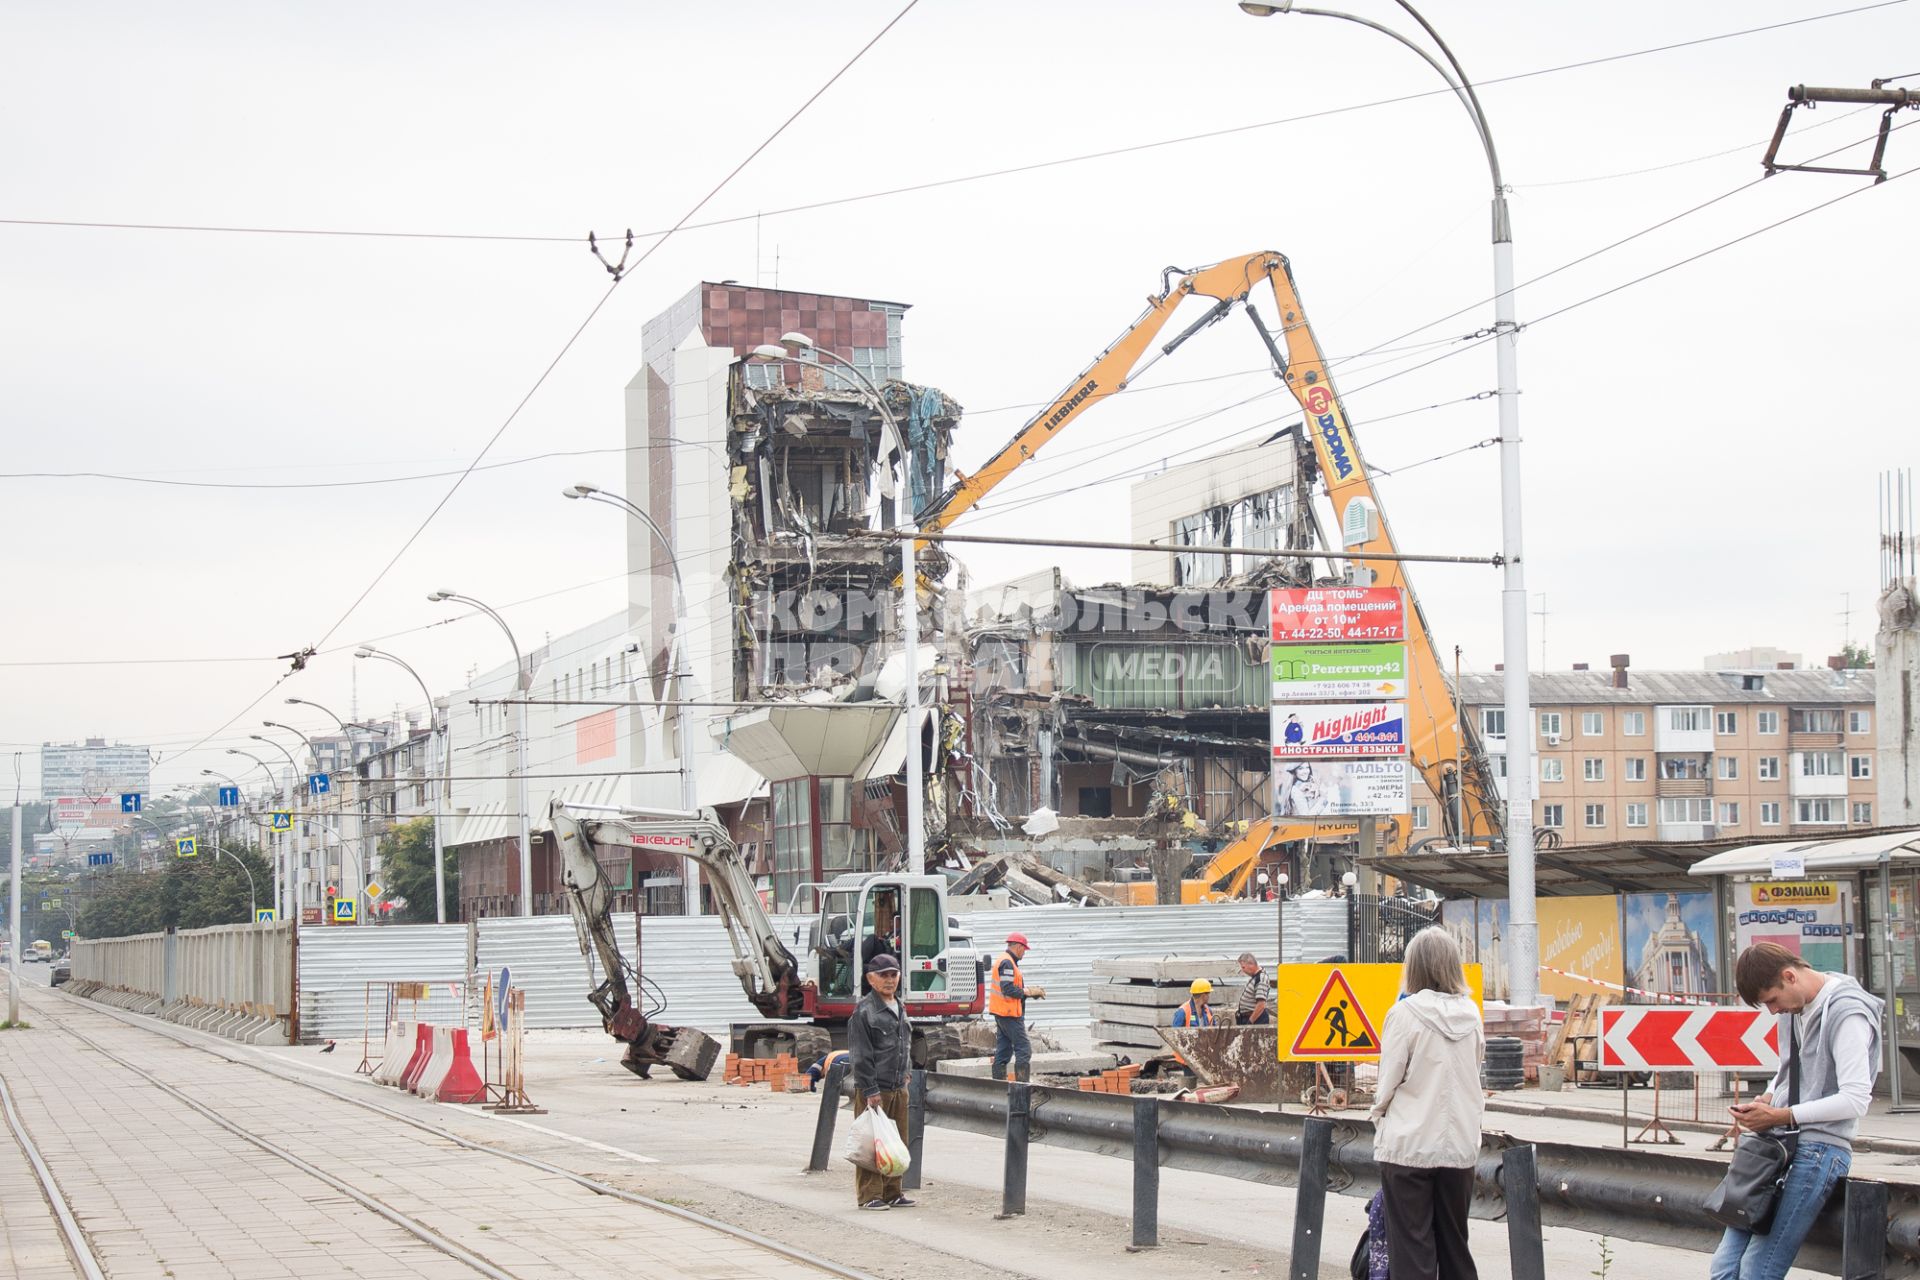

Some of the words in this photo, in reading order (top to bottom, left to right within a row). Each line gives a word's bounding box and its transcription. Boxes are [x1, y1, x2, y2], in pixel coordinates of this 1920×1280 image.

[1044, 380, 1099, 431] LIEBHERR
[1307, 590, 1324, 601] ДЦ
[1279, 603, 1324, 614] Аренда
[1327, 600, 1396, 612] помещений
[1314, 616, 1329, 625] от
[1292, 628, 1344, 639] 44-22-50,
[1347, 626, 1397, 637] 44-17-17
[1312, 662, 1400, 676] Репетитор42
[1312, 705, 1387, 742] Highlight
[1355, 732, 1398, 742] 441-641
[1280, 745, 1359, 754] ИНОСТРАННЫЕ
[1363, 745, 1398, 753] ЯЗЫКИ
[1345, 763, 1404, 774] ПАЛЬТО
[630, 834, 691, 847] TAKEUCHI
[1771, 885, 1830, 897] ФЭМИЛИ
